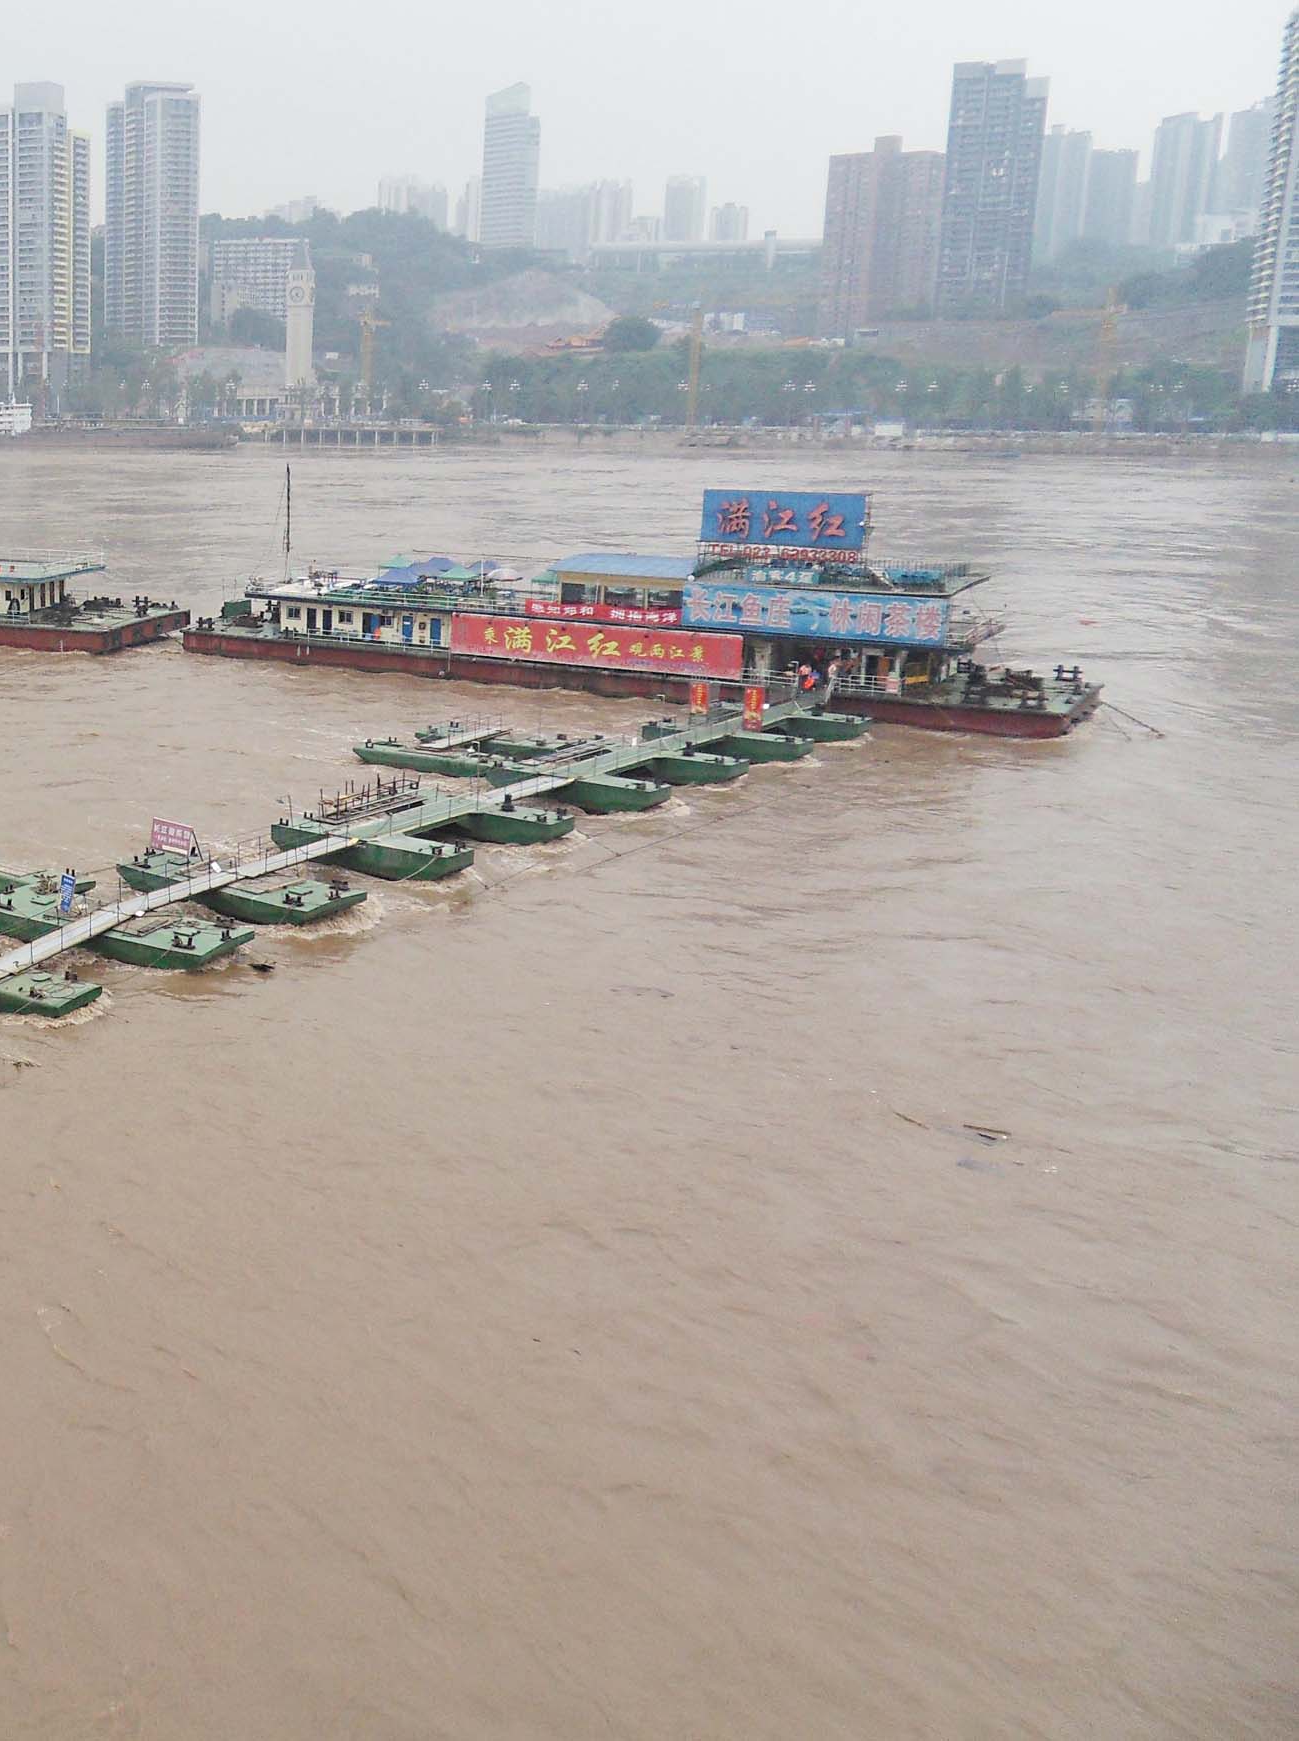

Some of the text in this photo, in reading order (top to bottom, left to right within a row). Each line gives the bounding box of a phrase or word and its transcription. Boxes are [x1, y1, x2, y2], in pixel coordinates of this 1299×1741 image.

[717, 498, 846, 542] 满江红
[687, 591, 942, 640] 长江鱼庄 休闲茶楼
